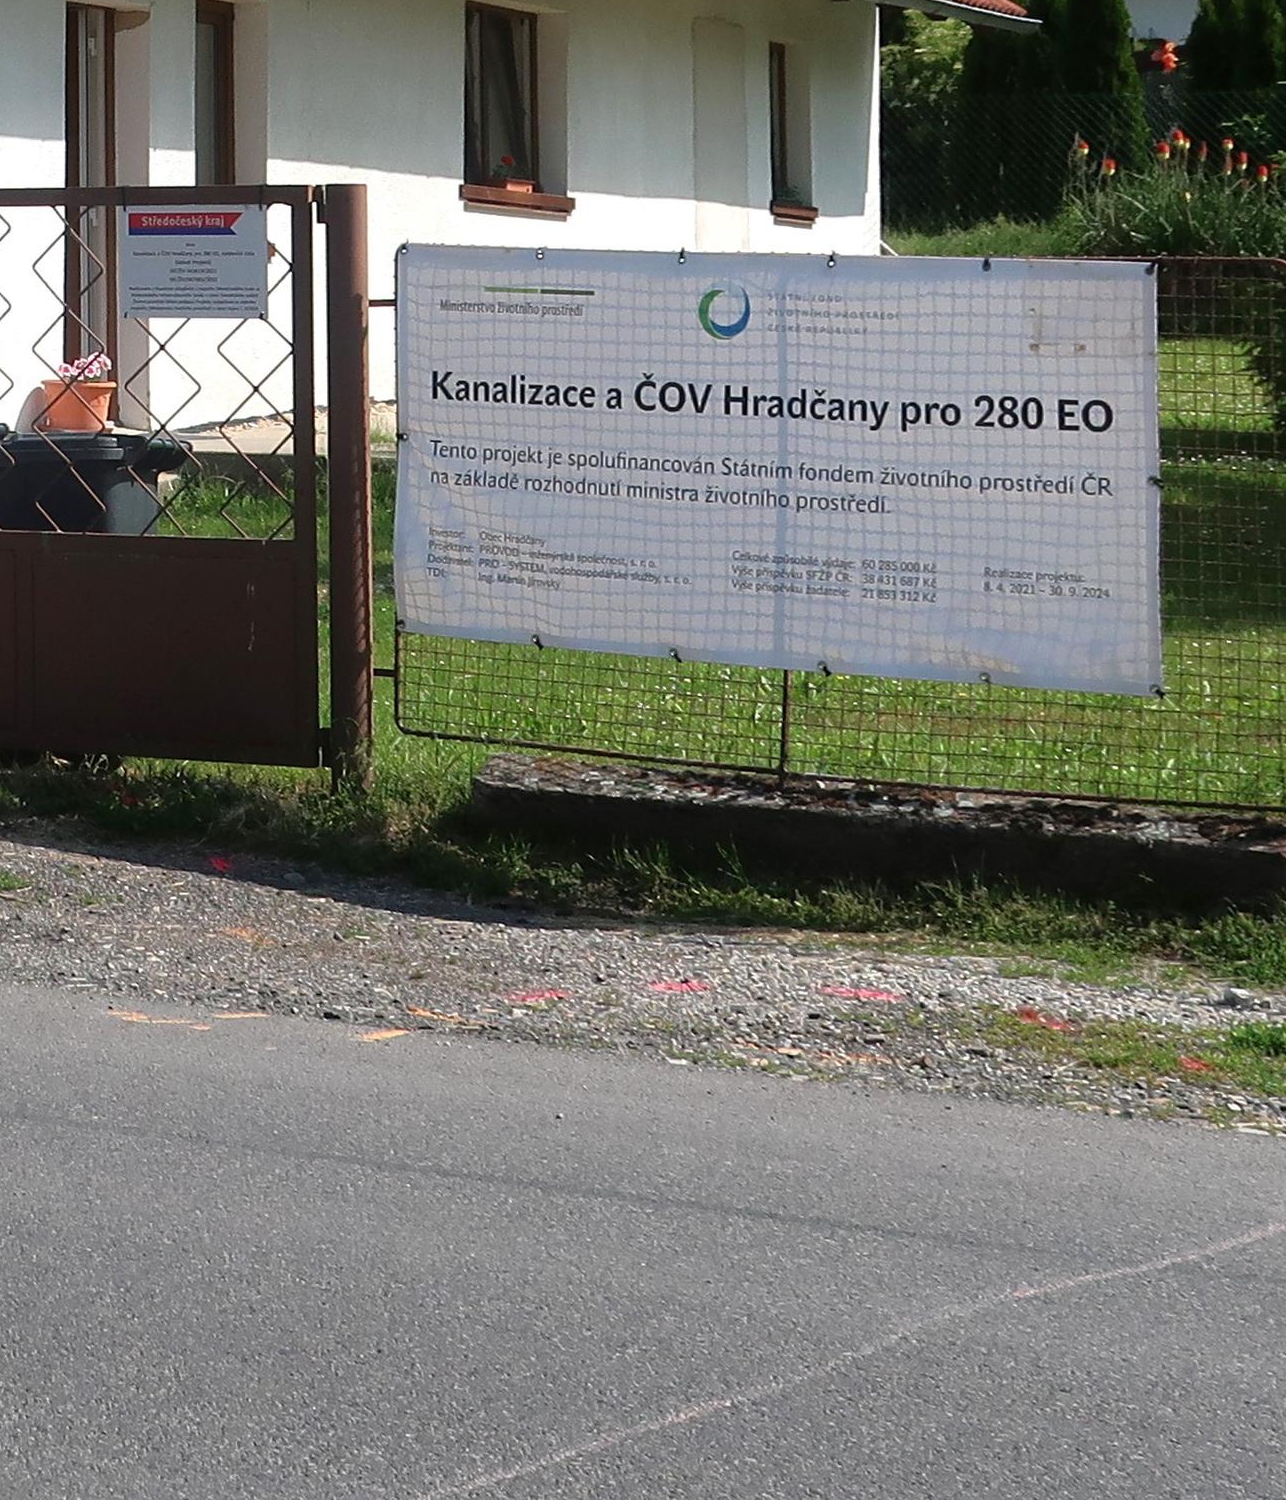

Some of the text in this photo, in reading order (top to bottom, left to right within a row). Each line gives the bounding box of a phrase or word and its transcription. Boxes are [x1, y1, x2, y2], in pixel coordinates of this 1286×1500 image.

[141, 214, 225, 229] Středočeský kraj
[439, 299, 585, 318] Ministerstvo životního prostředí
[431, 370, 1114, 432] Kanalizace a ČOV Hradčany pro 280 EO
[430, 439, 1114, 496] Tento projekt je spolufinancován Státním fondem životního prostředí ČR
[430, 469, 892, 514] na základě rozhodnutí ministra životního prostředí.
[862, 560, 876, 570] 60
[878, 560, 898, 572] 285
[900, 562, 921, 573] 000
[983, 566, 1034, 581] Realizace
[862, 573, 875, 585] 38
[899, 576, 920, 587] 687
[861, 587, 874, 598] 21
[899, 590, 920, 602] 312
[1009, 583, 1035, 595] 2021
[1082, 587, 1111, 599] 2024
